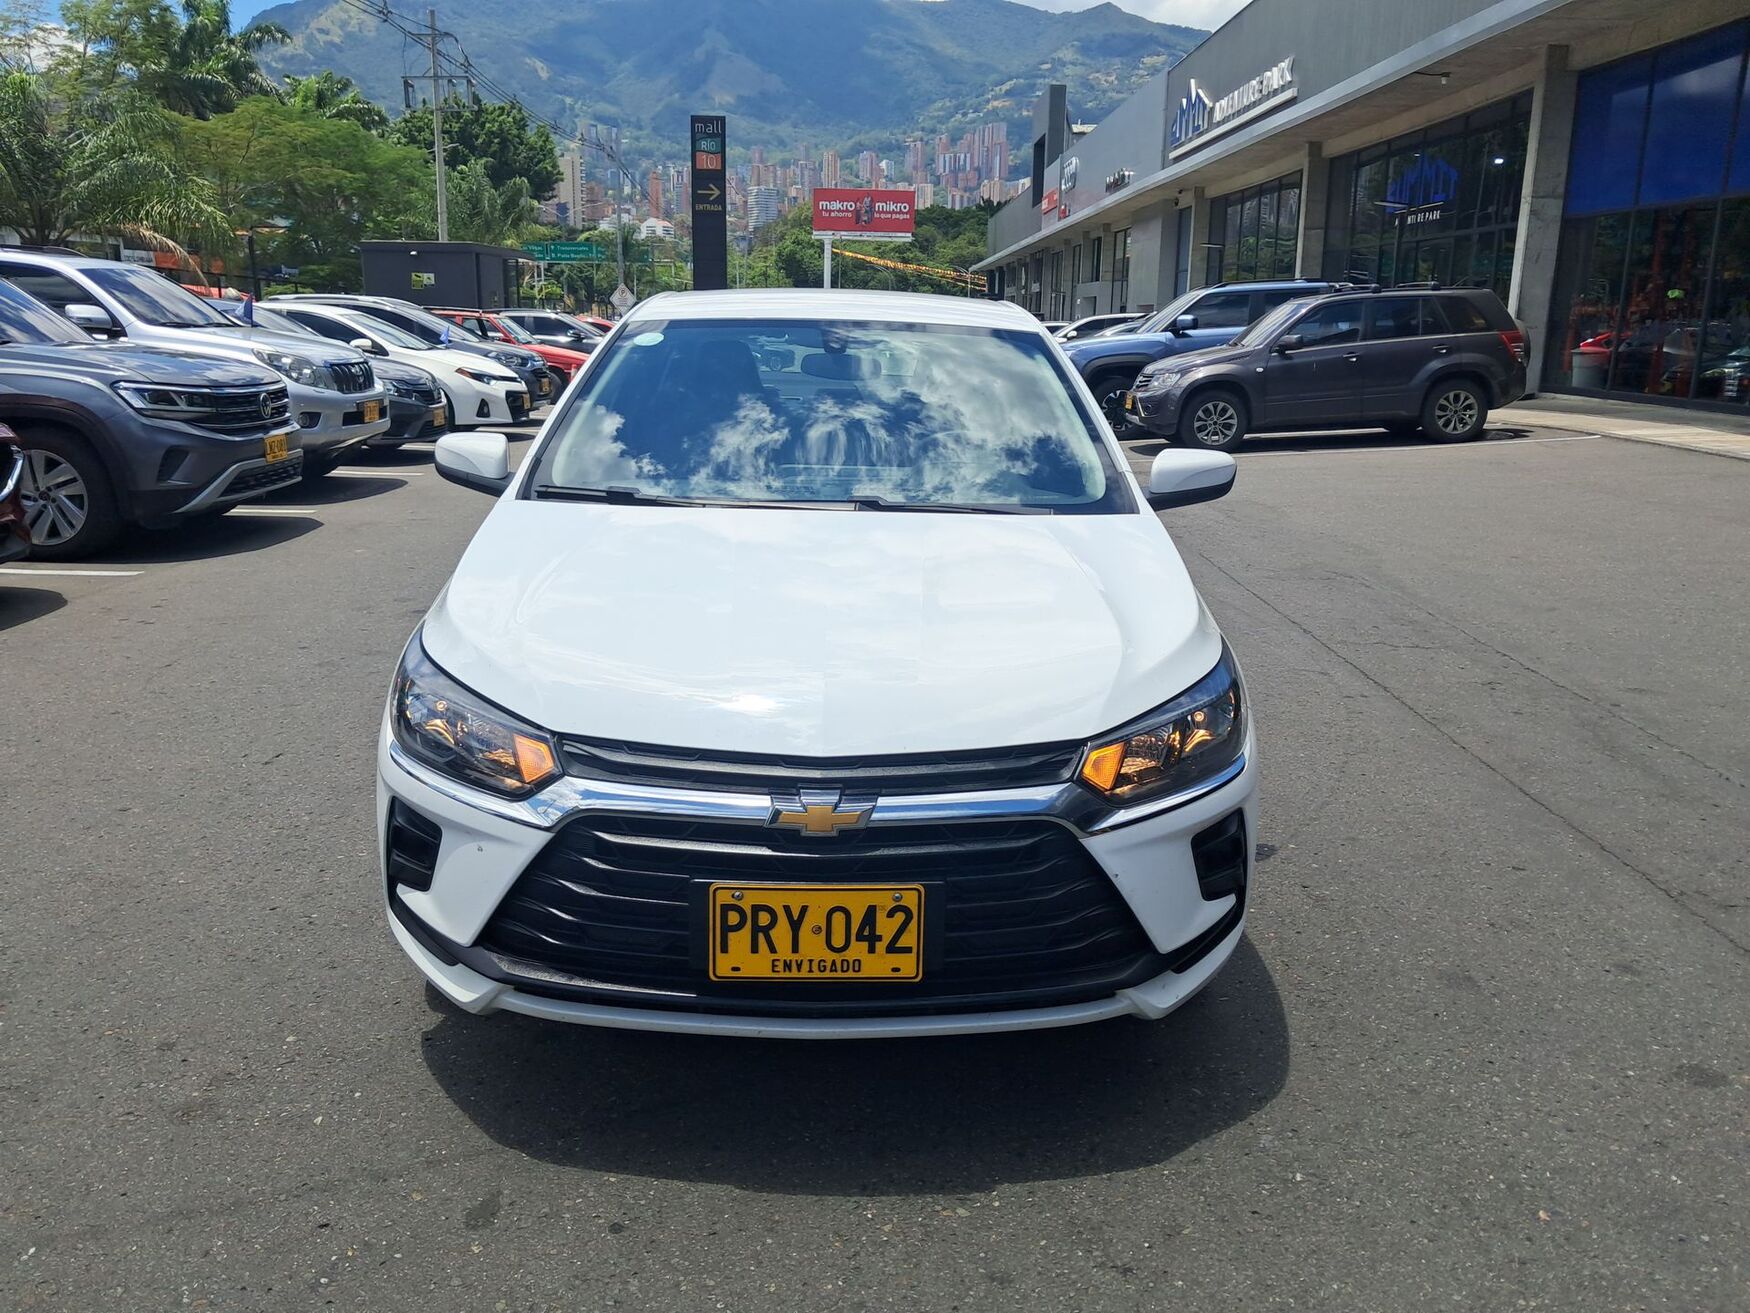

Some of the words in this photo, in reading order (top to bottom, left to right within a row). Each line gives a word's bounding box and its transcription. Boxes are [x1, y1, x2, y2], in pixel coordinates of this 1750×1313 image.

[695, 120, 722, 134] mall
[702, 154, 717, 169] 10
[695, 203, 722, 211] ENTRADA
[819, 200, 855, 211] makro
[875, 201, 909, 212] mikro
[1425, 210, 1441, 222] PARK
[720, 904, 809, 954] PRY
[825, 905, 914, 954] 042
[771, 958, 862, 973] ENVIGADO
